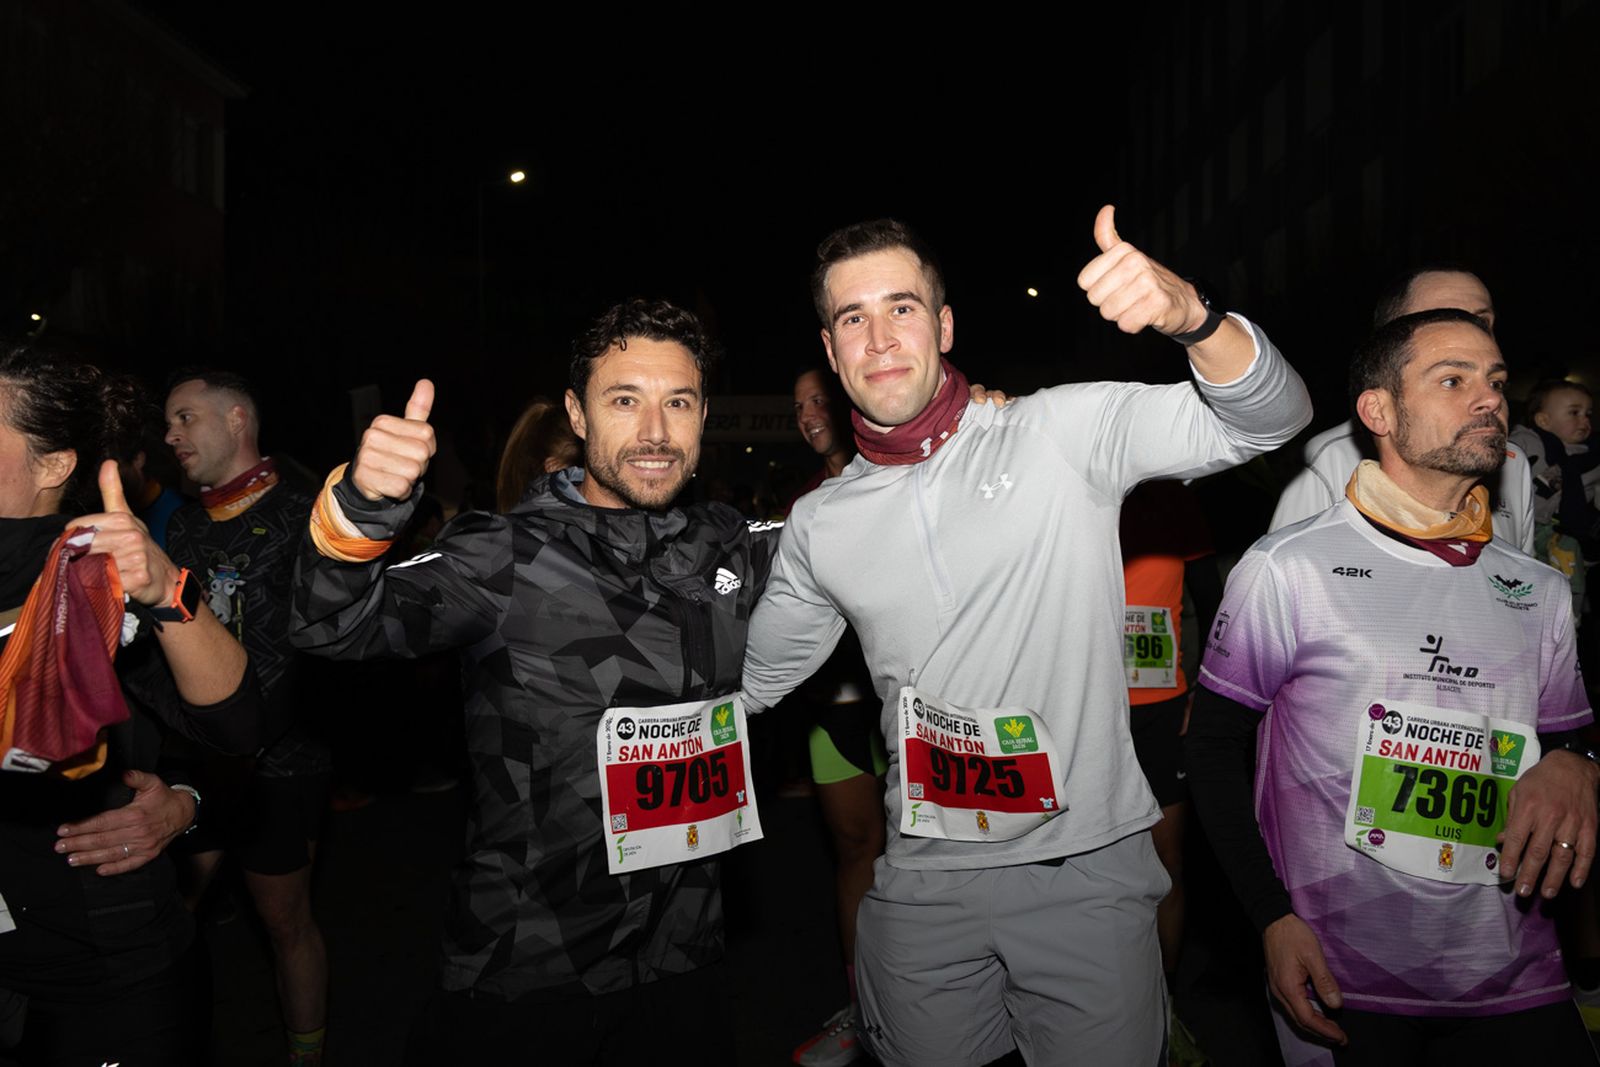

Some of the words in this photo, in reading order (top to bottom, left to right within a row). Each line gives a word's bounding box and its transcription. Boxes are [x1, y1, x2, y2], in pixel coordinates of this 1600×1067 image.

[705, 415, 740, 430] ERA
[1332, 567, 1373, 579] 42K
[1125, 614, 1135, 623] HE
[618, 722, 635, 735] 43
[638, 721, 686, 739] NOCHE
[687, 718, 702, 734] DE
[926, 711, 961, 734] NOCHE
[963, 722, 981, 737] DE
[1382, 715, 1402, 728] 43
[1406, 715, 1429, 724] CARRERA
[1430, 719, 1450, 728] URBANA
[618, 744, 653, 762] SAN
[657, 734, 704, 759] ANTÓN
[916, 723, 938, 743] SAN
[940, 732, 985, 754] ANTÓN
[1405, 723, 1462, 746] NOCHE
[1465, 733, 1484, 750] DE
[1379, 739, 1419, 761] SAN
[1421, 747, 1482, 772] ANTÓN
[636, 751, 729, 811] 9705
[930, 748, 1025, 798] 9725
[1391, 764, 1498, 828] 7369
[1435, 825, 1462, 840] LUIS
